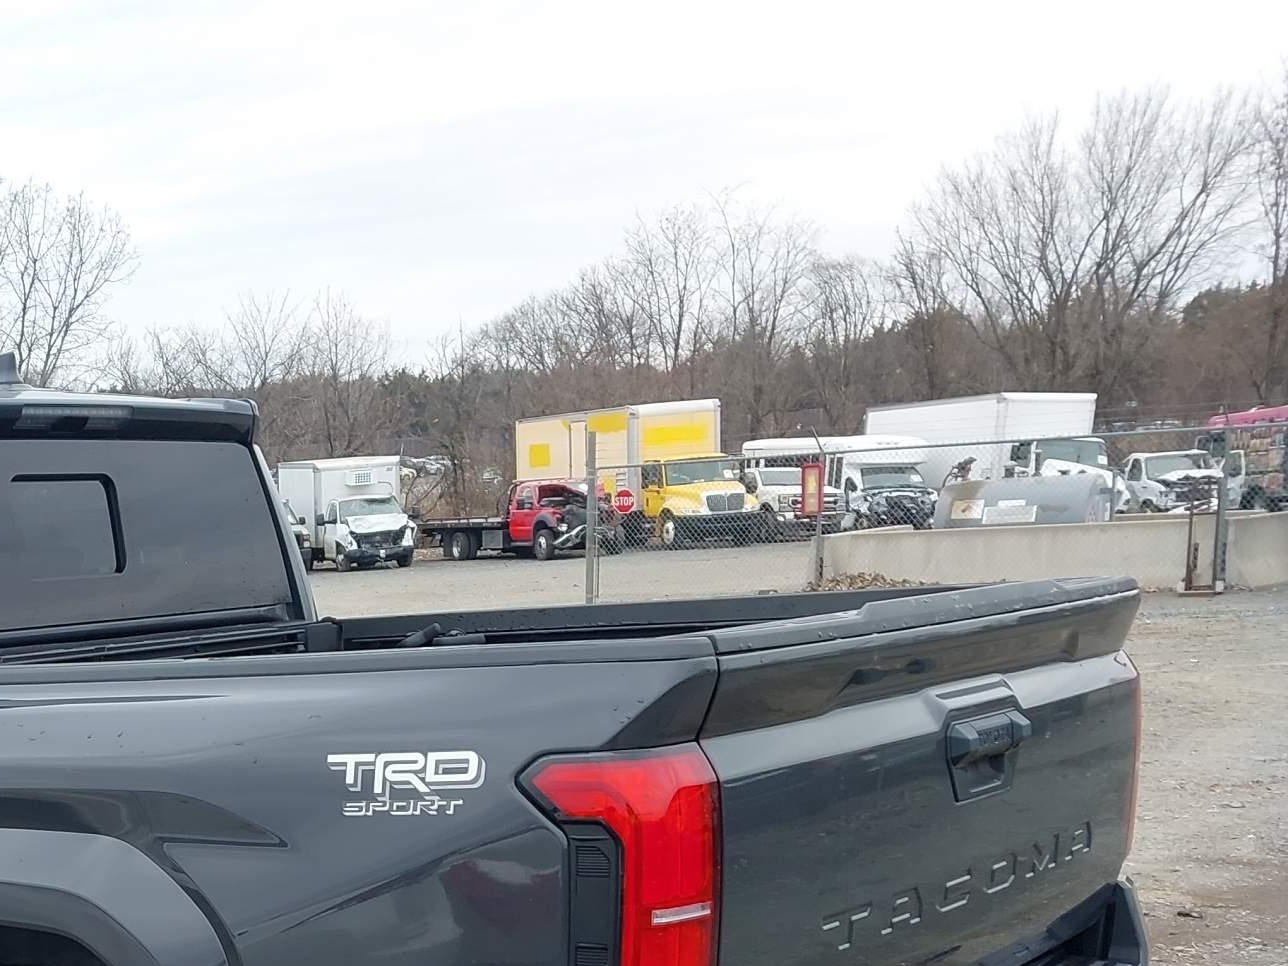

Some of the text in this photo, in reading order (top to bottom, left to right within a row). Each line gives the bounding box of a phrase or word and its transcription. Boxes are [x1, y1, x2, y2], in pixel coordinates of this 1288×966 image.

[615, 496, 634, 506] STOP
[327, 750, 486, 801] TRD
[342, 799, 464, 816] SPORT
[821, 821, 1093, 951] TACOMA
